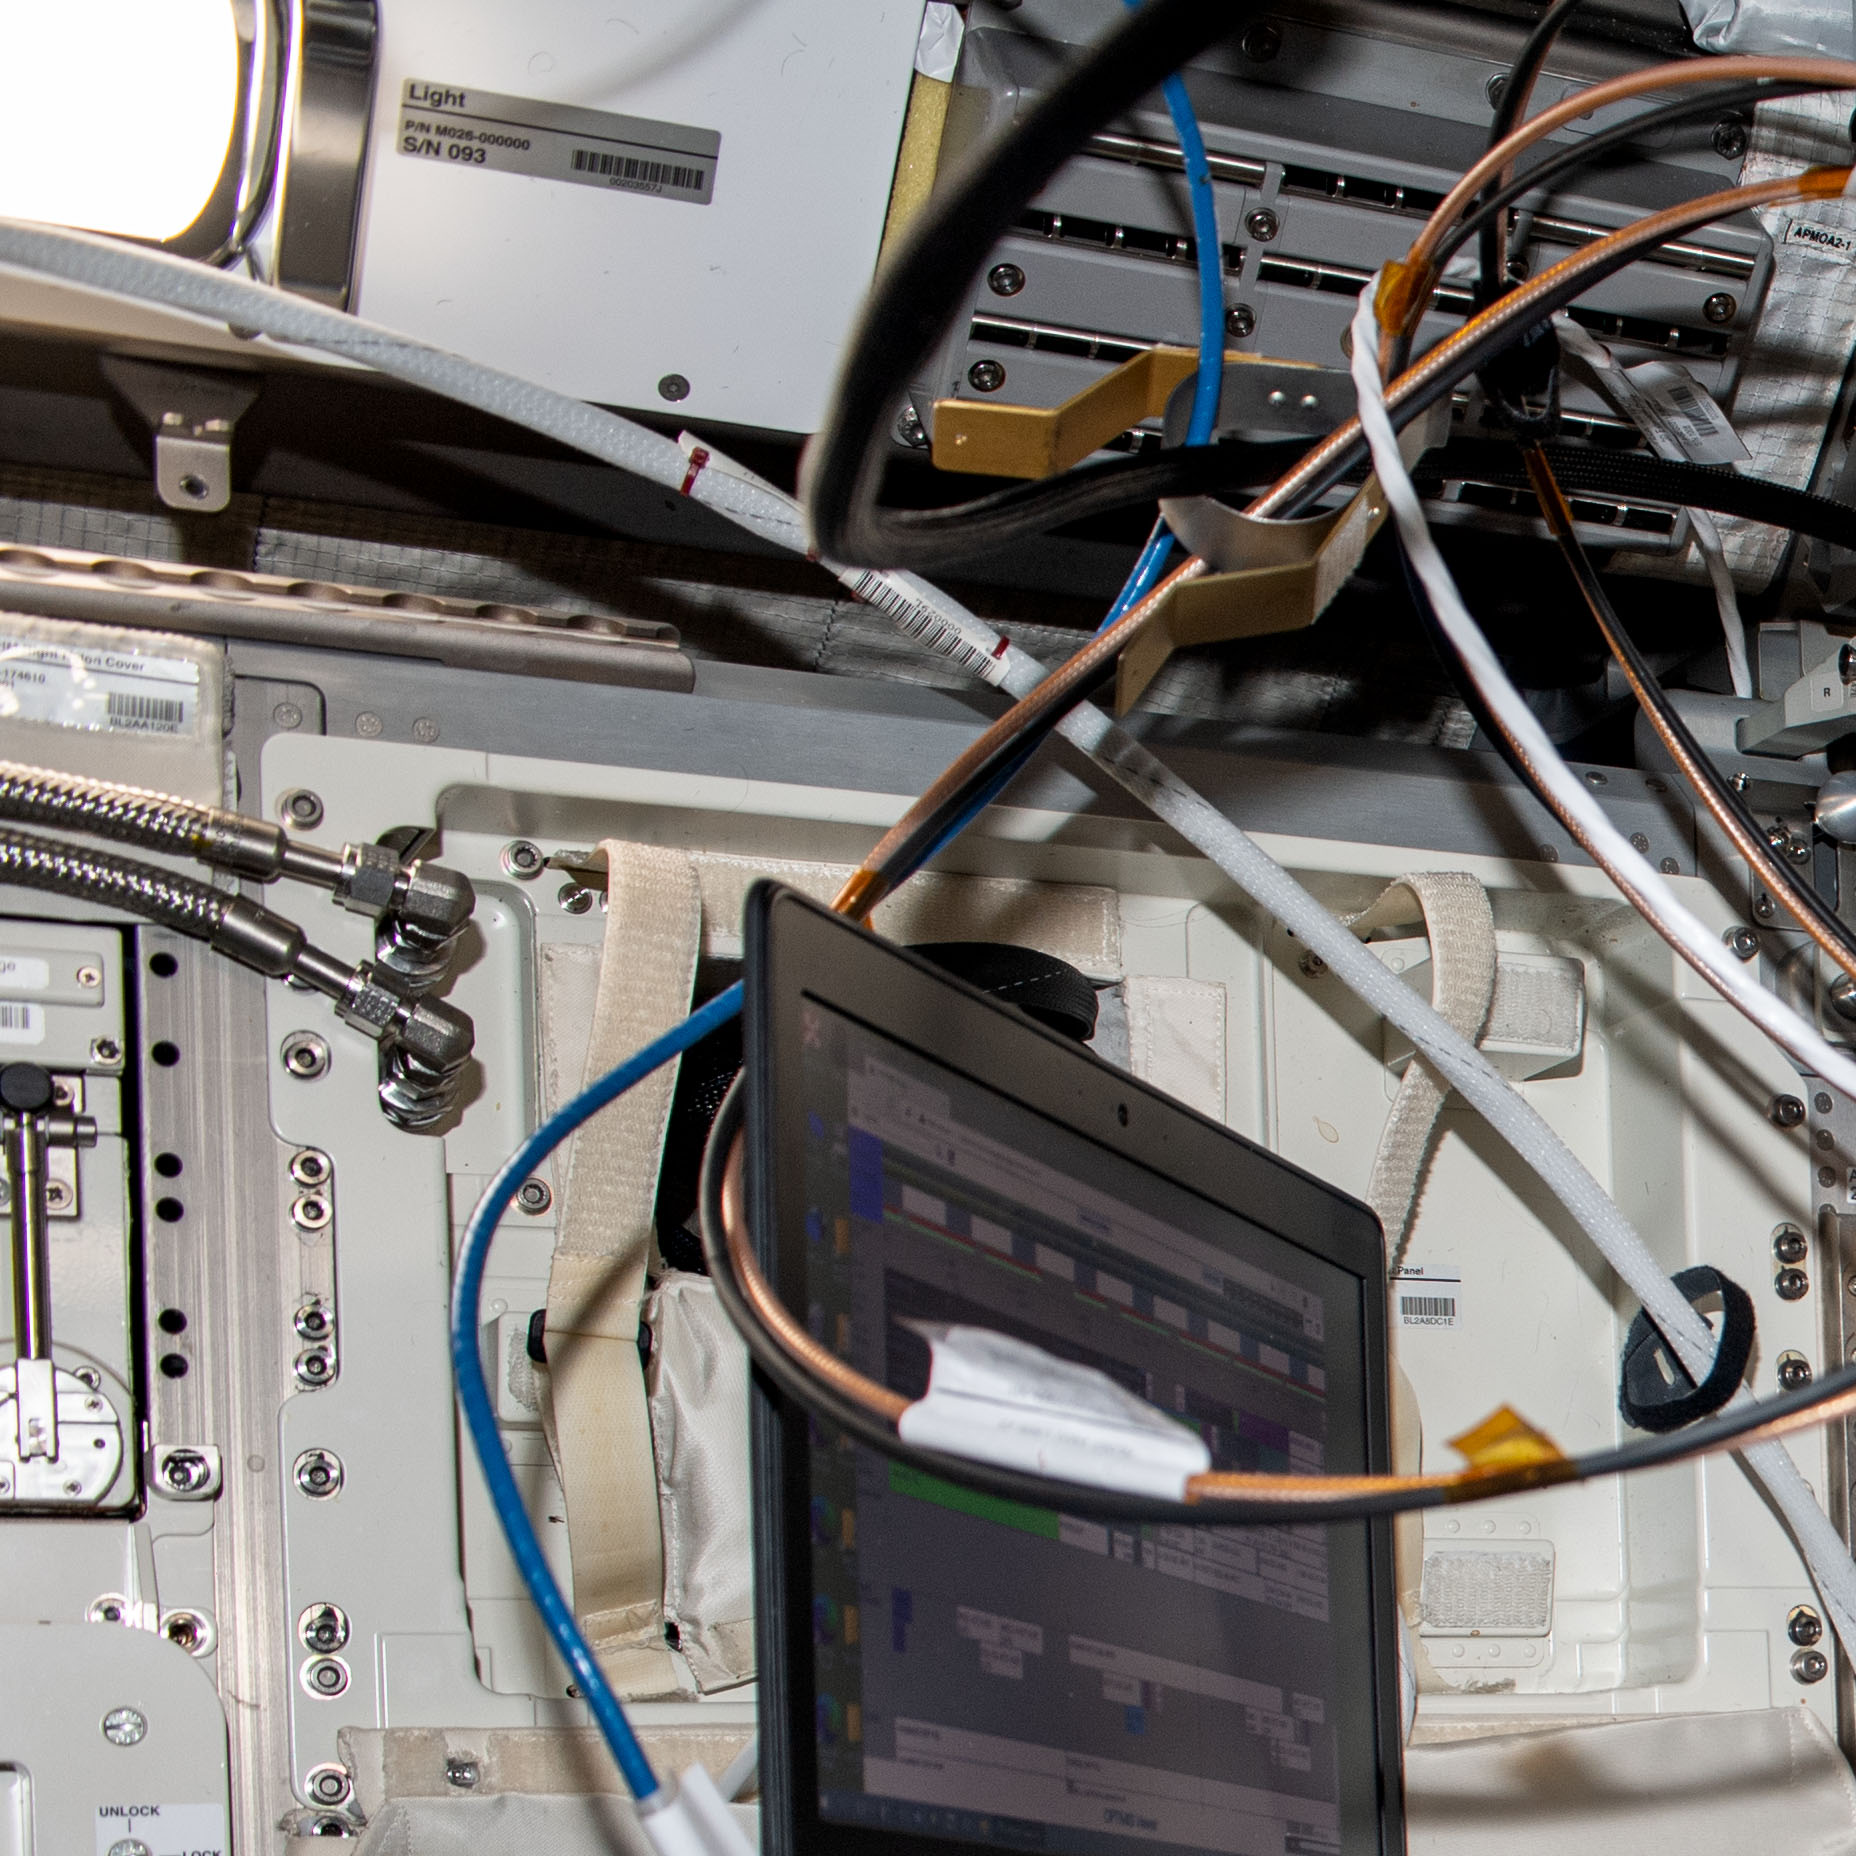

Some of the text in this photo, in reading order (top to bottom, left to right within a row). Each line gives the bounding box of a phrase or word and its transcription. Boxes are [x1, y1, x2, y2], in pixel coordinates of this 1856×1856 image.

[407, 83, 465, 110] Light
[404, 120, 431, 135] P/N
[402, 138, 486, 166] S/N 093
[106, 661, 145, 677] Cover
[1823, 687, 1831, 698] R
[1398, 1266, 1424, 1276] Panel
[98, 1805, 161, 1817] UNLOCK
